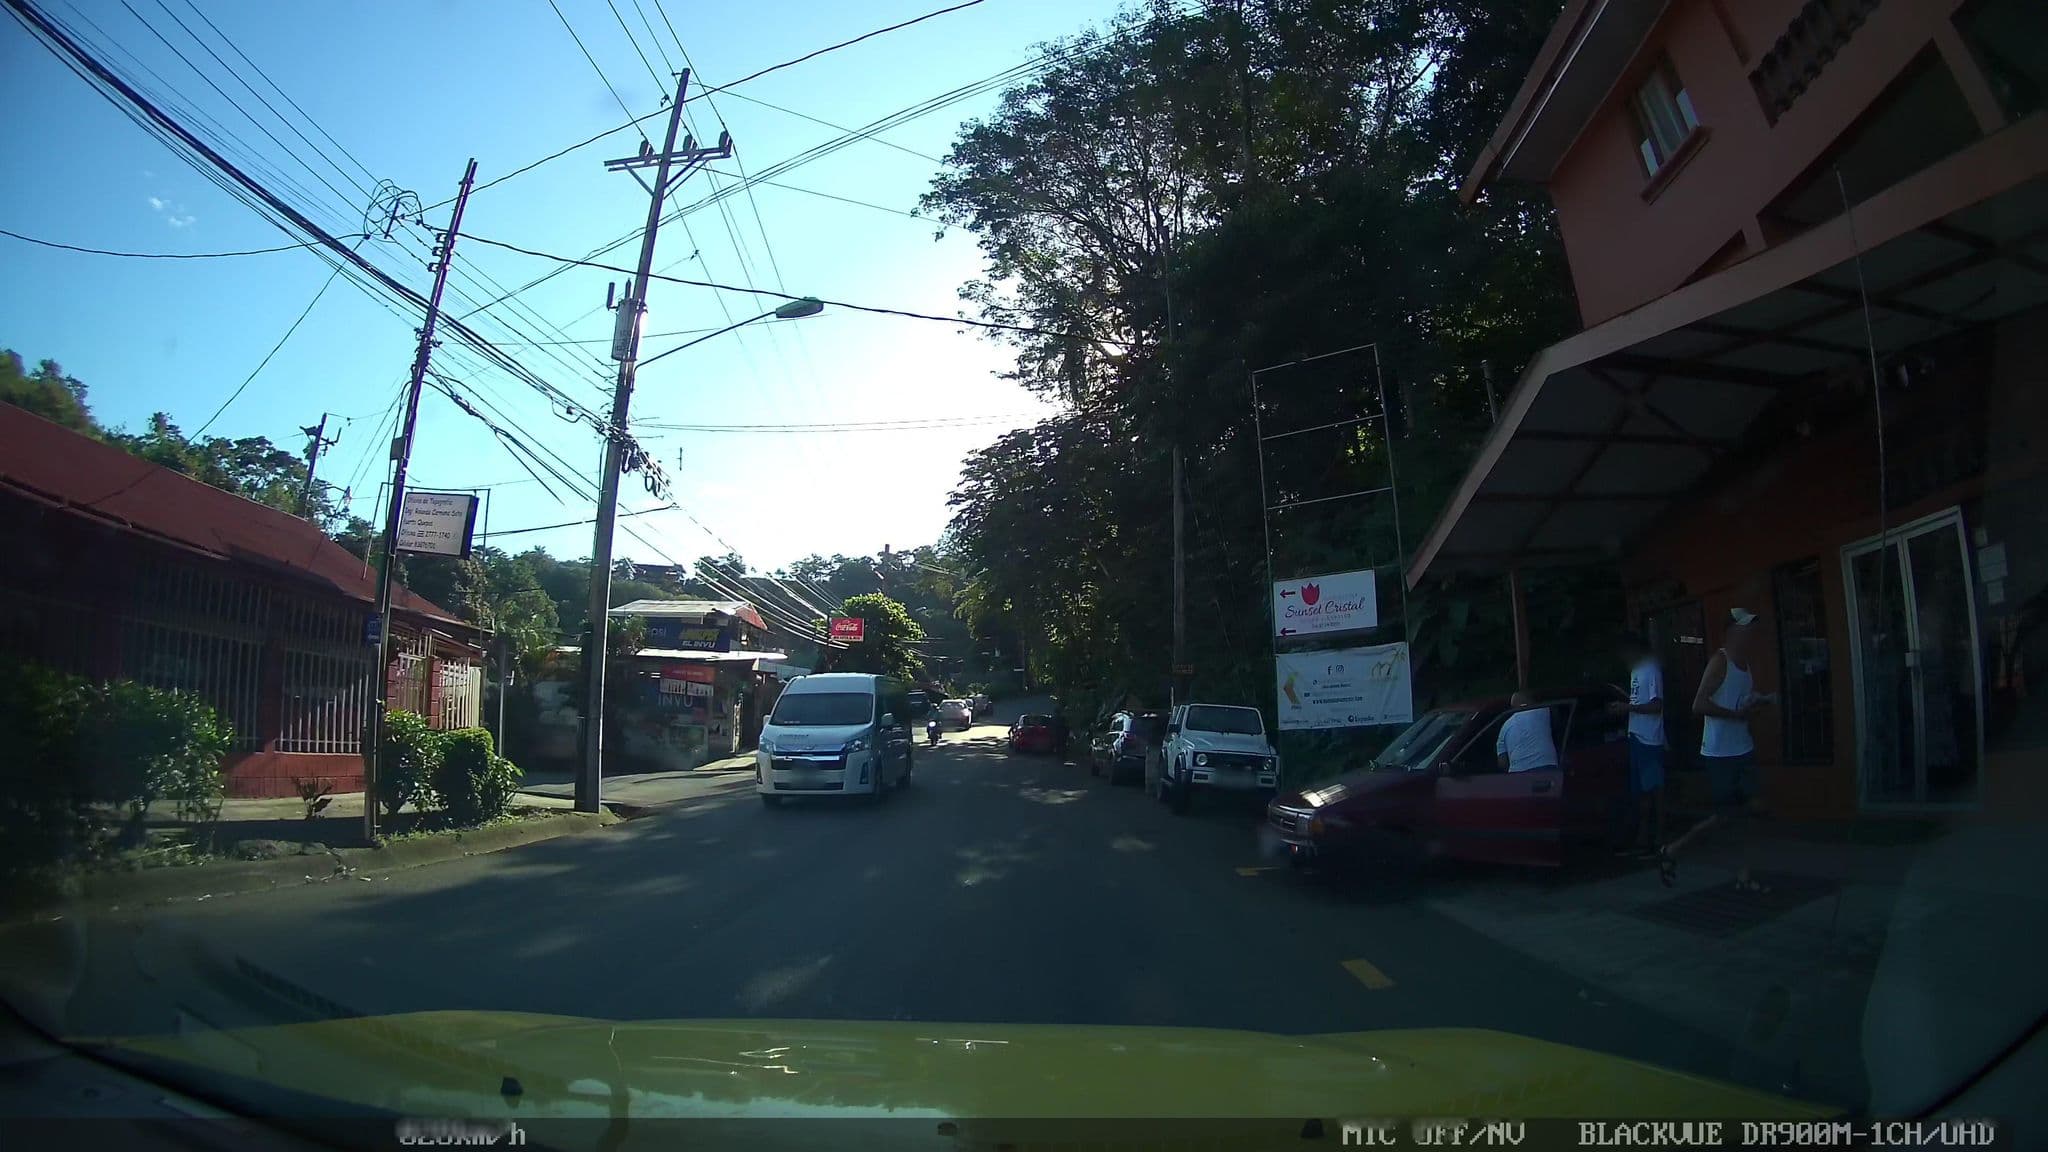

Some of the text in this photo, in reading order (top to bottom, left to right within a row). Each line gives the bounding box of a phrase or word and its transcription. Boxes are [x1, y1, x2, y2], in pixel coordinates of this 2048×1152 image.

[1285, 604, 1322, 618] Sunset
[1325, 597, 1364, 614] Cristal
[693, 640, 716, 649] INVU
[657, 694, 694, 708] INVU
